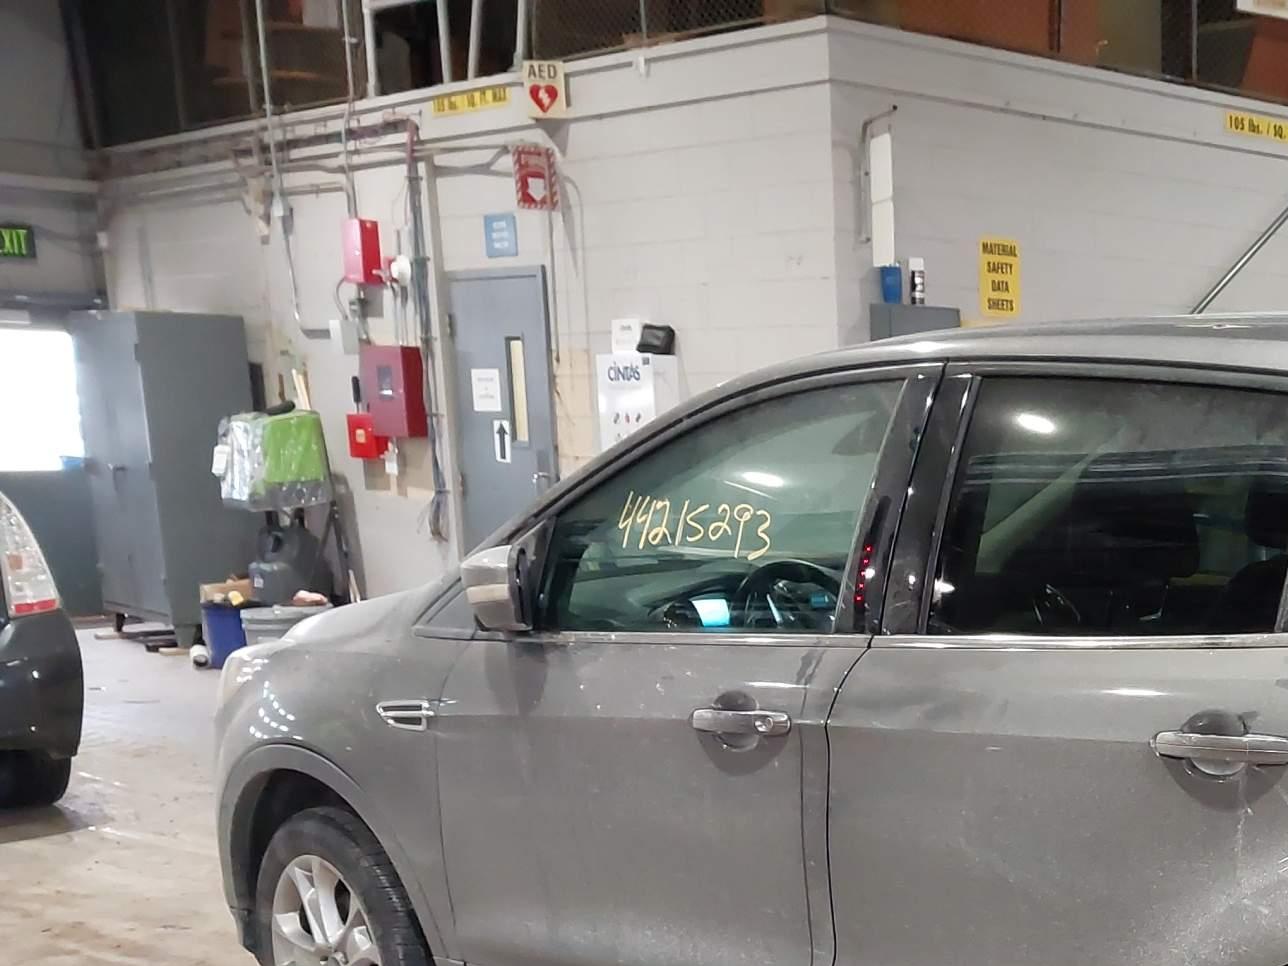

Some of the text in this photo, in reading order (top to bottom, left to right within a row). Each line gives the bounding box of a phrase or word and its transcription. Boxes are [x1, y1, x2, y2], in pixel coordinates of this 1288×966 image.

[527, 63, 558, 79] AED
[1229, 115, 1245, 131] 105
[0, 229, 27, 255] XIT
[982, 241, 1017, 257] MATERIAL
[987, 261, 1013, 275] SAFETY
[991, 279, 1010, 293] DATA
[987, 297, 1014, 312] SHEETS
[618, 490, 771, 561] 44215293
